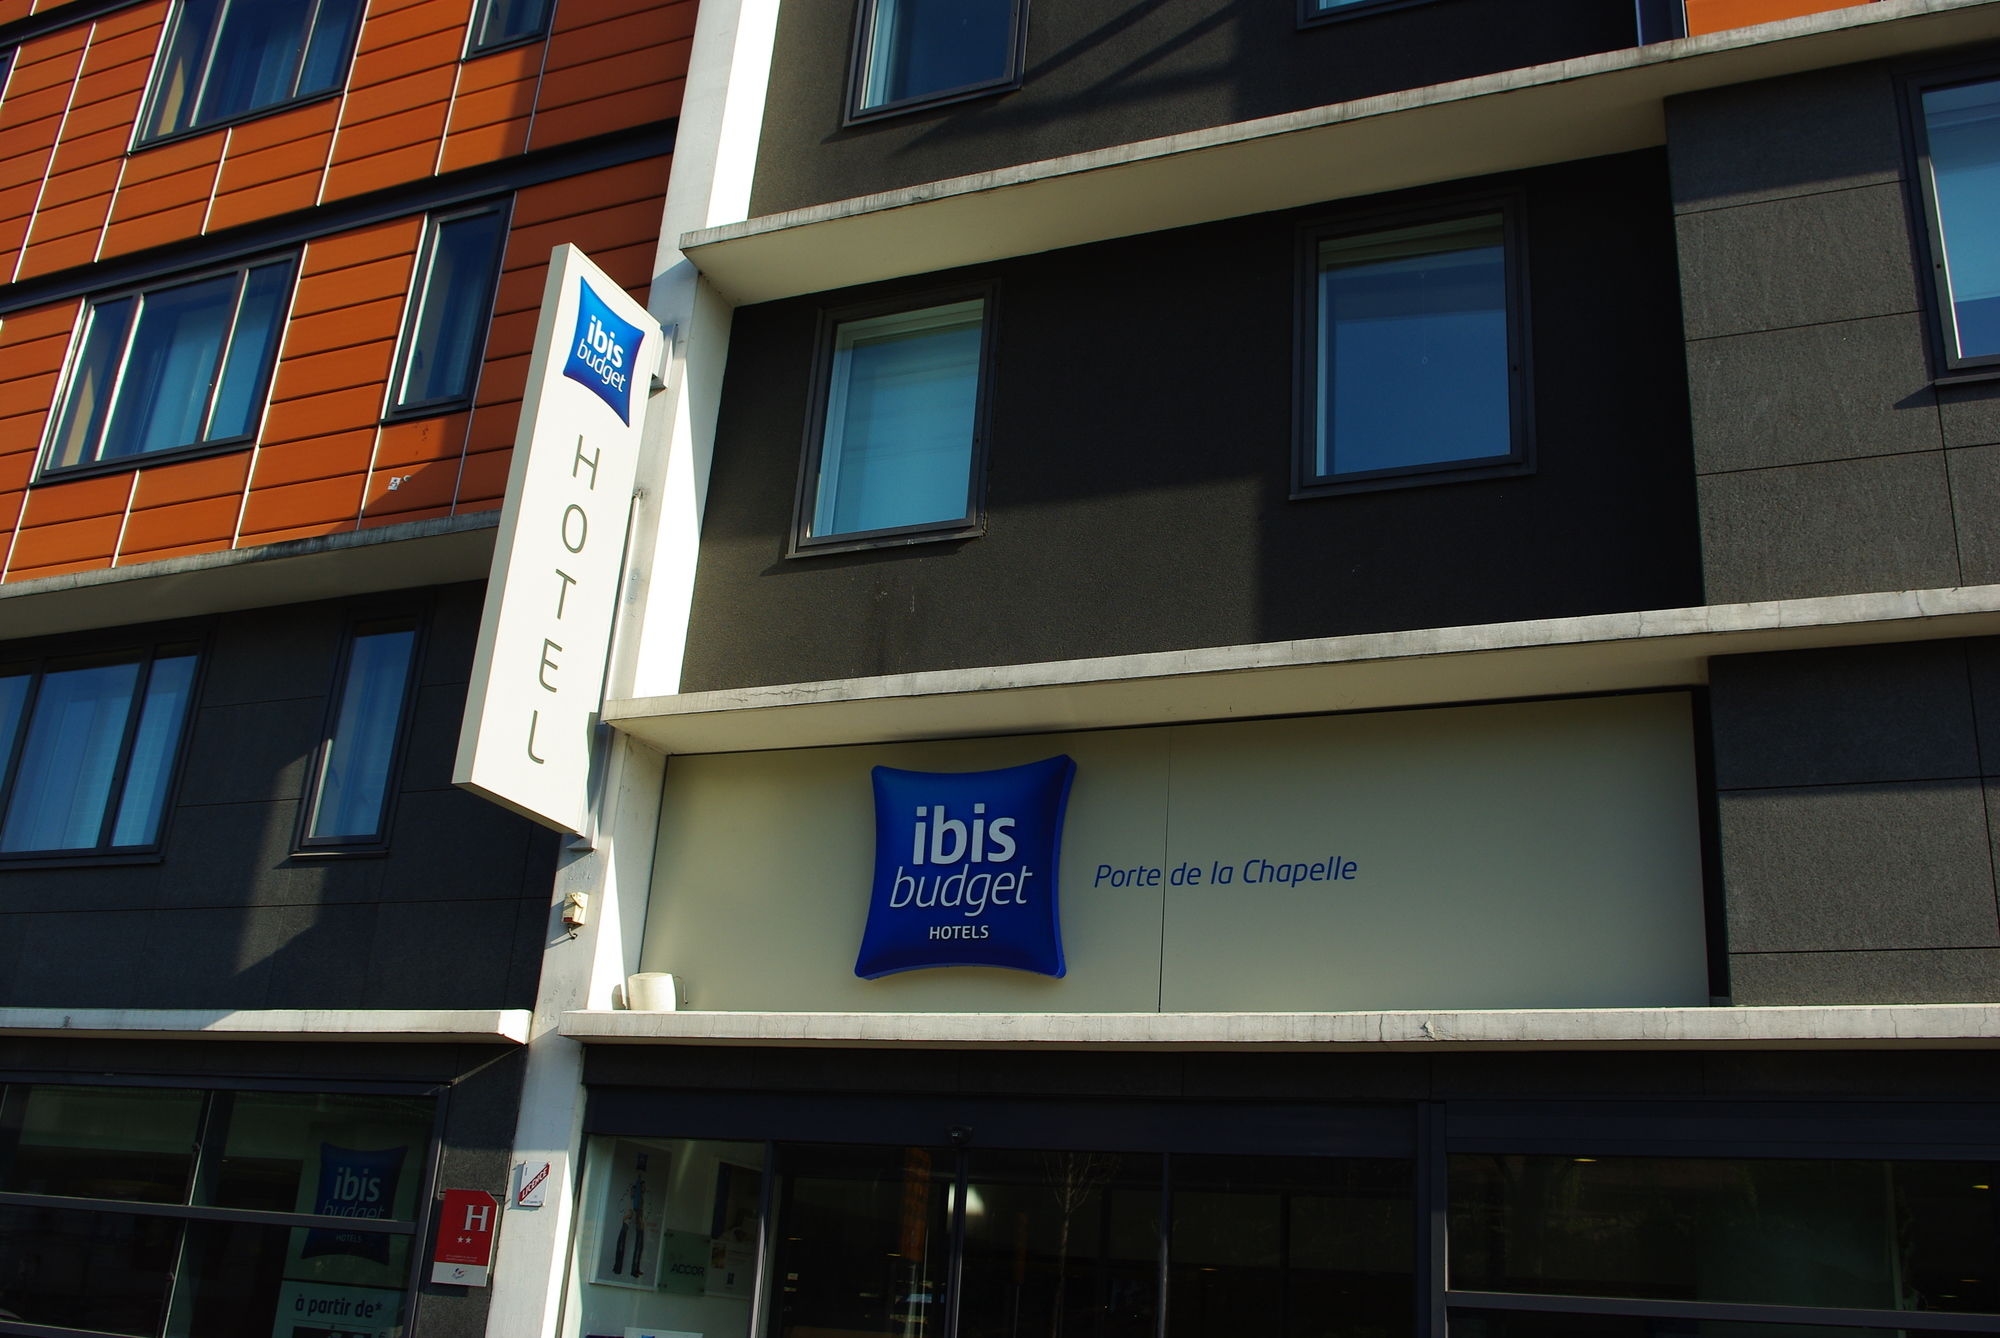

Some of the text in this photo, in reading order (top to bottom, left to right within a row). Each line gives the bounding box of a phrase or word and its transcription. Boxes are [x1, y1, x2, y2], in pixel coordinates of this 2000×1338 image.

[587, 314, 624, 368] ibis
[577, 338, 626, 392] budget
[527, 434, 600, 764] HOTEL
[912, 803, 1016, 865] ibis
[1094, 856, 1358, 888] Porte de la Chapelle
[889, 864, 1032, 917] budget
[929, 924, 989, 941] HOTELS
[333, 1166, 382, 1202] ibis
[521, 1165, 549, 1199] LICENCE
[463, 1204, 492, 1232] H
[307, 1297, 351, 1316] partir
